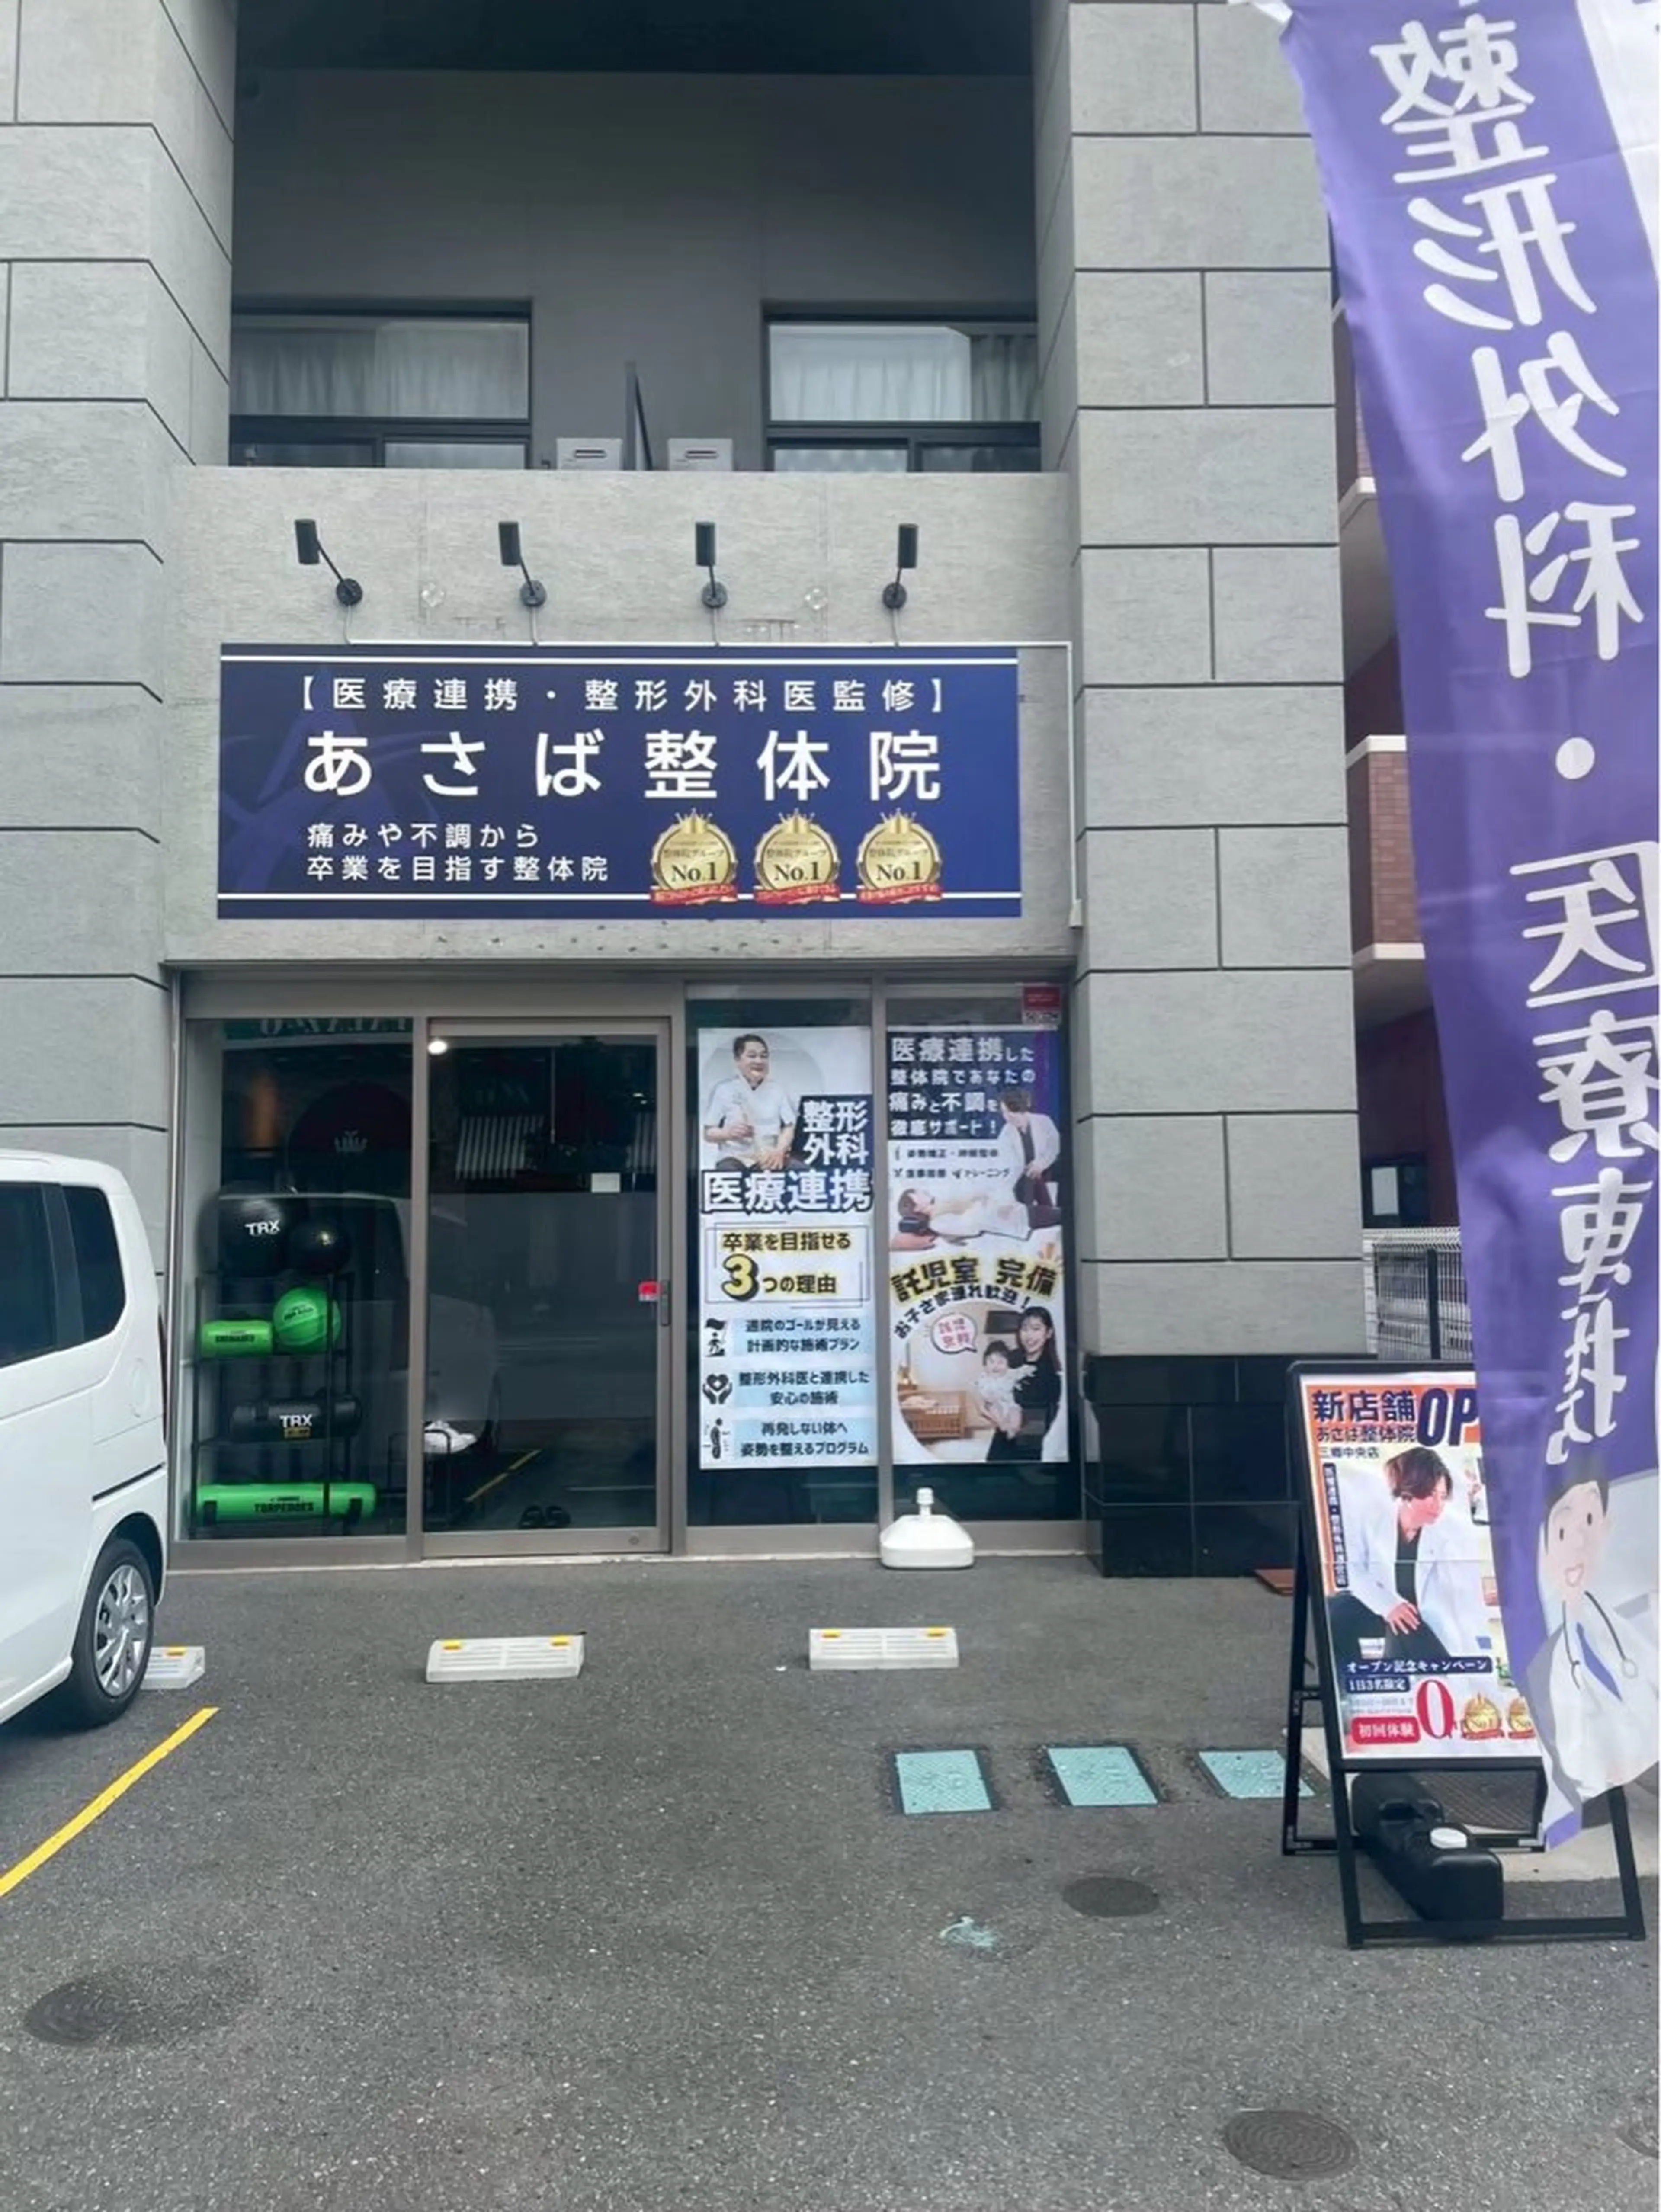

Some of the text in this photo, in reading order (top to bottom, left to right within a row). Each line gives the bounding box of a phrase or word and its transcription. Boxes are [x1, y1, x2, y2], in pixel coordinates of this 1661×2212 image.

[303, 676, 942, 712] 【医療連携・整形外科医監修】
[304, 728, 941, 801] あさば整体院
[307, 823, 538, 848] 痛みや不調から
[307, 856, 608, 881] 卒業を目指す整体院
[672, 862, 716, 882] No.1
[774, 862, 819, 881] No.1
[876, 861, 920, 881] No.1
[891, 1037, 1035, 1062] 医療連携した
[891, 1069, 1036, 1085] 整体院であなたの
[890, 1092, 998, 1113] 痛みと不調を
[803, 1100, 868, 1132] 整形
[803, 1133, 869, 1165] 外科
[703, 1170, 871, 1212] 医療連携
[245, 1220, 280, 1236] TRX
[722, 1233, 851, 1251] 卒業を目指せる
[721, 1254, 837, 1301] 3つの理由
[891, 1257, 1057, 1302] 託児室 完備
[745, 1318, 861, 1333] 通院のゴールが見える
[747, 1339, 860, 1352] 計画的な施術プラン
[738, 1371, 870, 1386] 整形外科医と連携した
[770, 1391, 838, 1405] 安心の施術
[1311, 1390, 1415, 1422] 新店舗
[280, 1414, 312, 1428] TRX
[761, 1421, 848, 1437] 再発しない体へ
[740, 1443, 869, 1457] 姿勢を整えるプログラム
